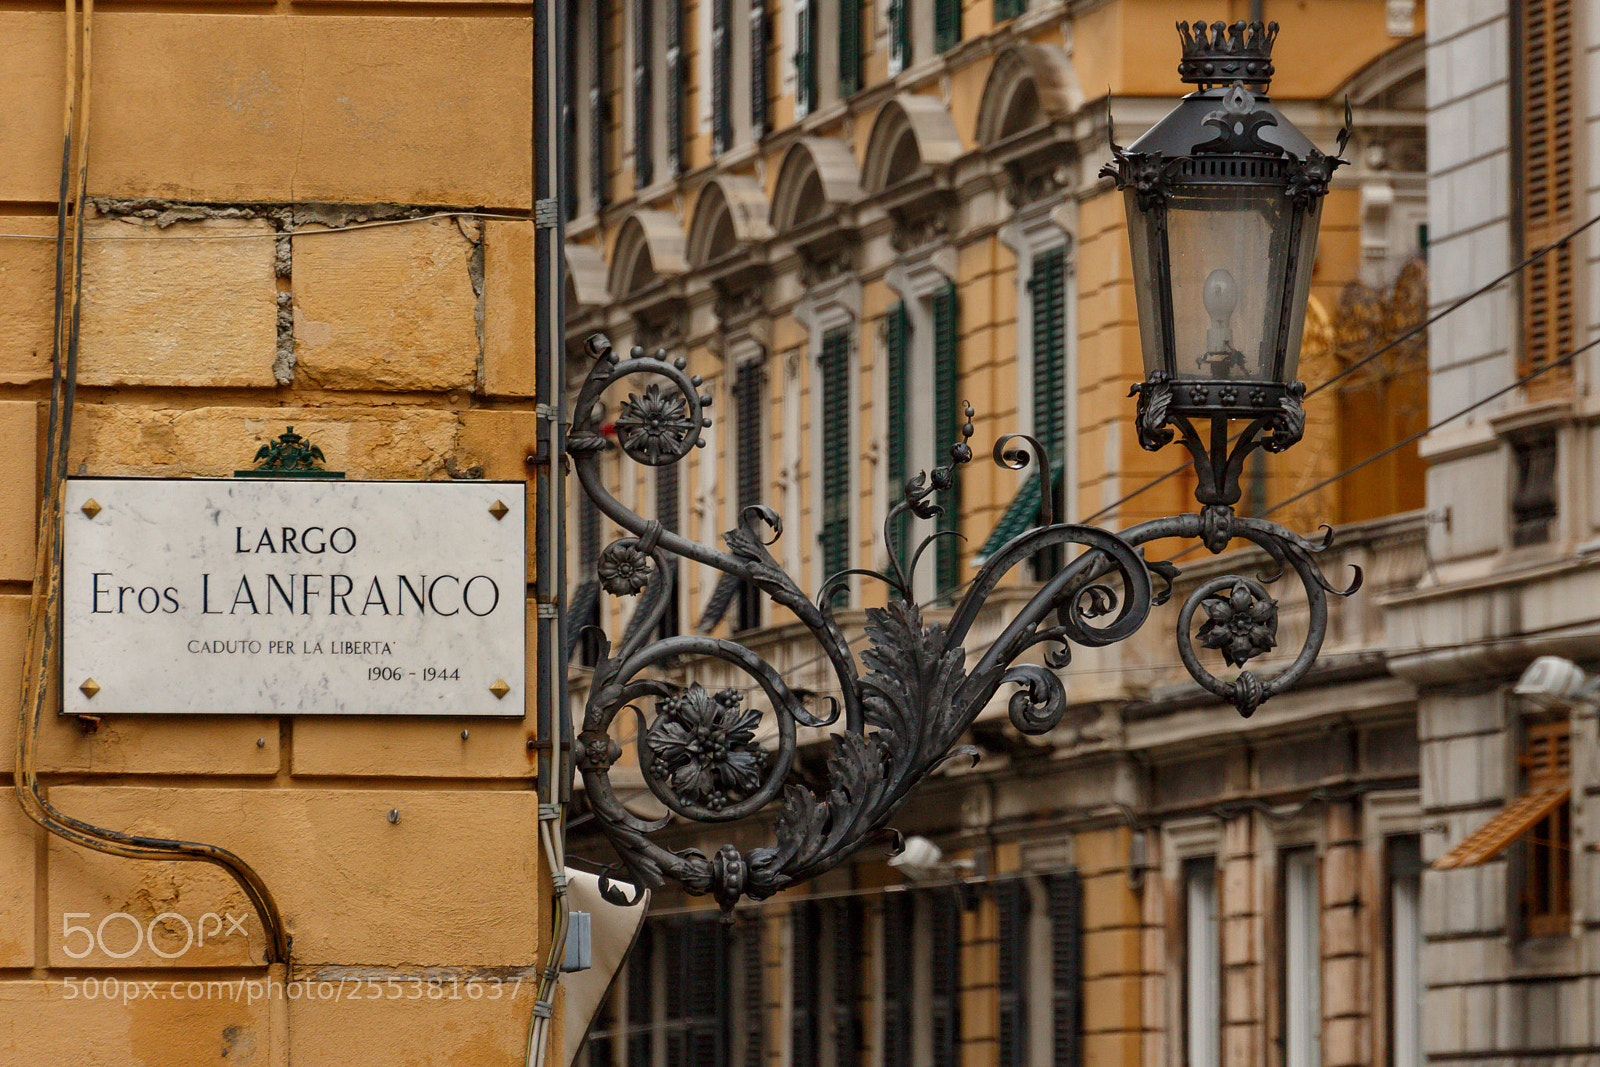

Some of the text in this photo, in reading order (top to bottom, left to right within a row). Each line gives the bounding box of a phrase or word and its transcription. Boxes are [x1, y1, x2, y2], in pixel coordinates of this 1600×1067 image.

[235, 526, 357, 554] LARGO
[91, 572, 501, 617] Eros LANFRANCO
[187, 640, 262, 655] CADUTO
[268, 641, 295, 655] PER
[303, 641, 324, 655] LA
[368, 667, 402, 682] 1906
[423, 667, 461, 682] 1944
